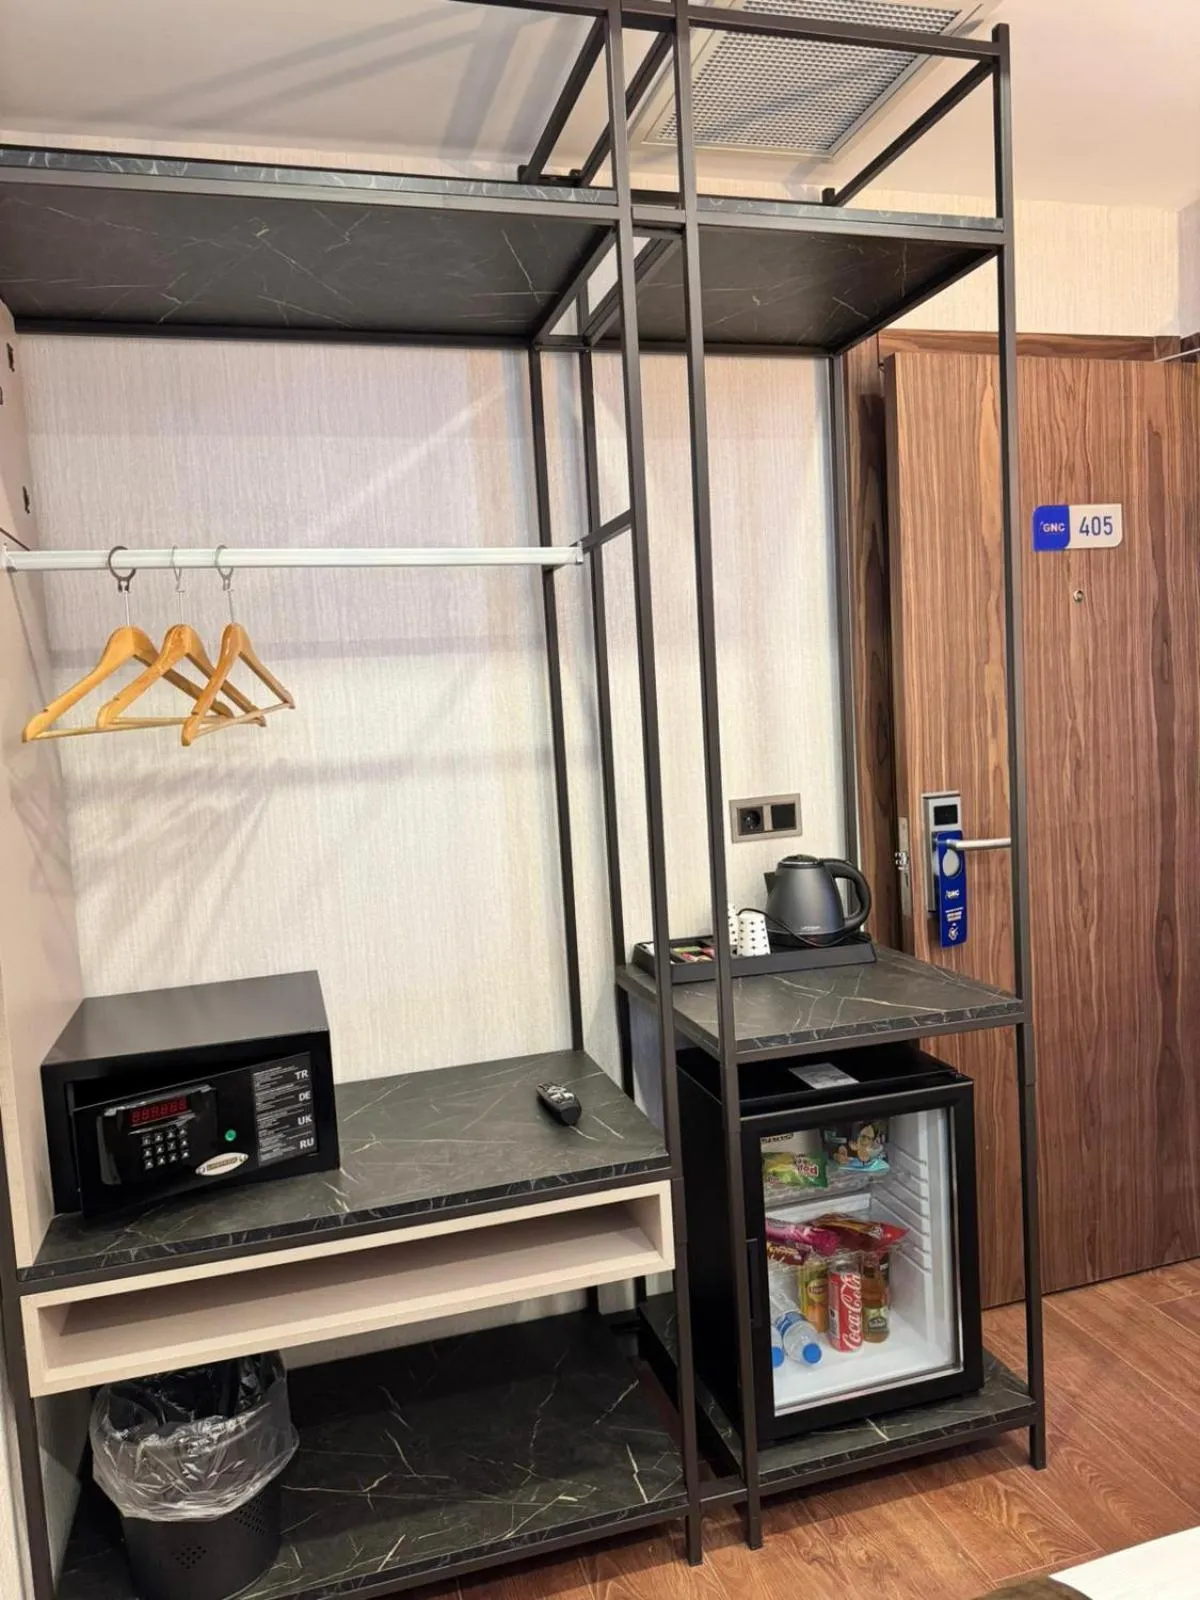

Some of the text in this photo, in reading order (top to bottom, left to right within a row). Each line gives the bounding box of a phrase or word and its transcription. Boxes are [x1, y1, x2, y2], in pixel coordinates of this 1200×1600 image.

[1042, 515, 1114, 537] GNC 405
[295, 1069, 309, 1080] TR
[299, 1091, 311, 1102] DE
[298, 1114, 313, 1126] UK
[300, 1137, 315, 1149] RU
